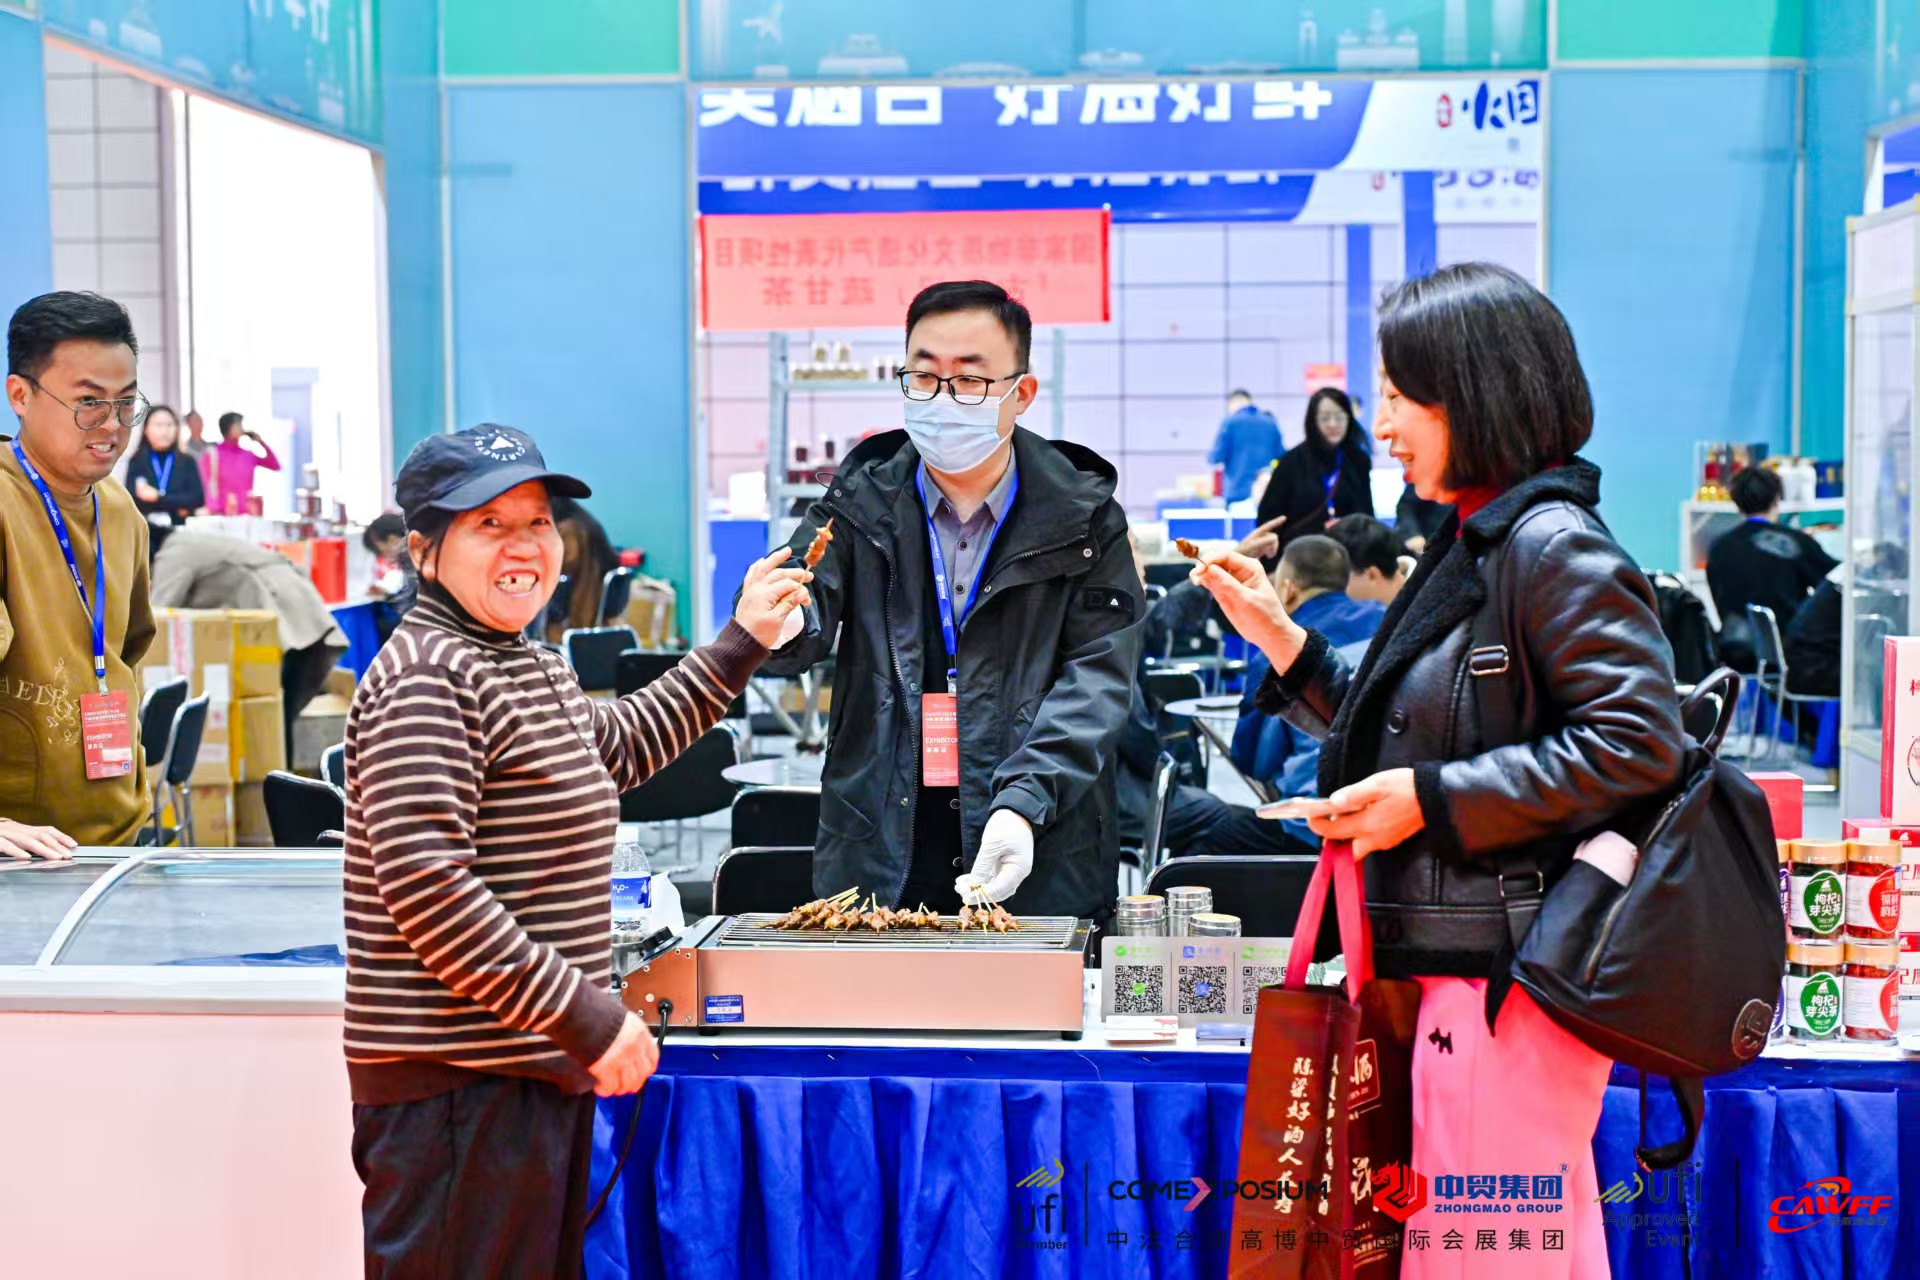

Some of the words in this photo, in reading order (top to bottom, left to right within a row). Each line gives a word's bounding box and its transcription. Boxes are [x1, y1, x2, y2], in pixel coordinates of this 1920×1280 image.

[1814, 893, 1837, 906] 枸杞
[1809, 904, 1841, 917] 芽尖茶
[1811, 994, 1834, 1007] 枸杞
[1805, 1005, 1838, 1018] 芽尖茶
